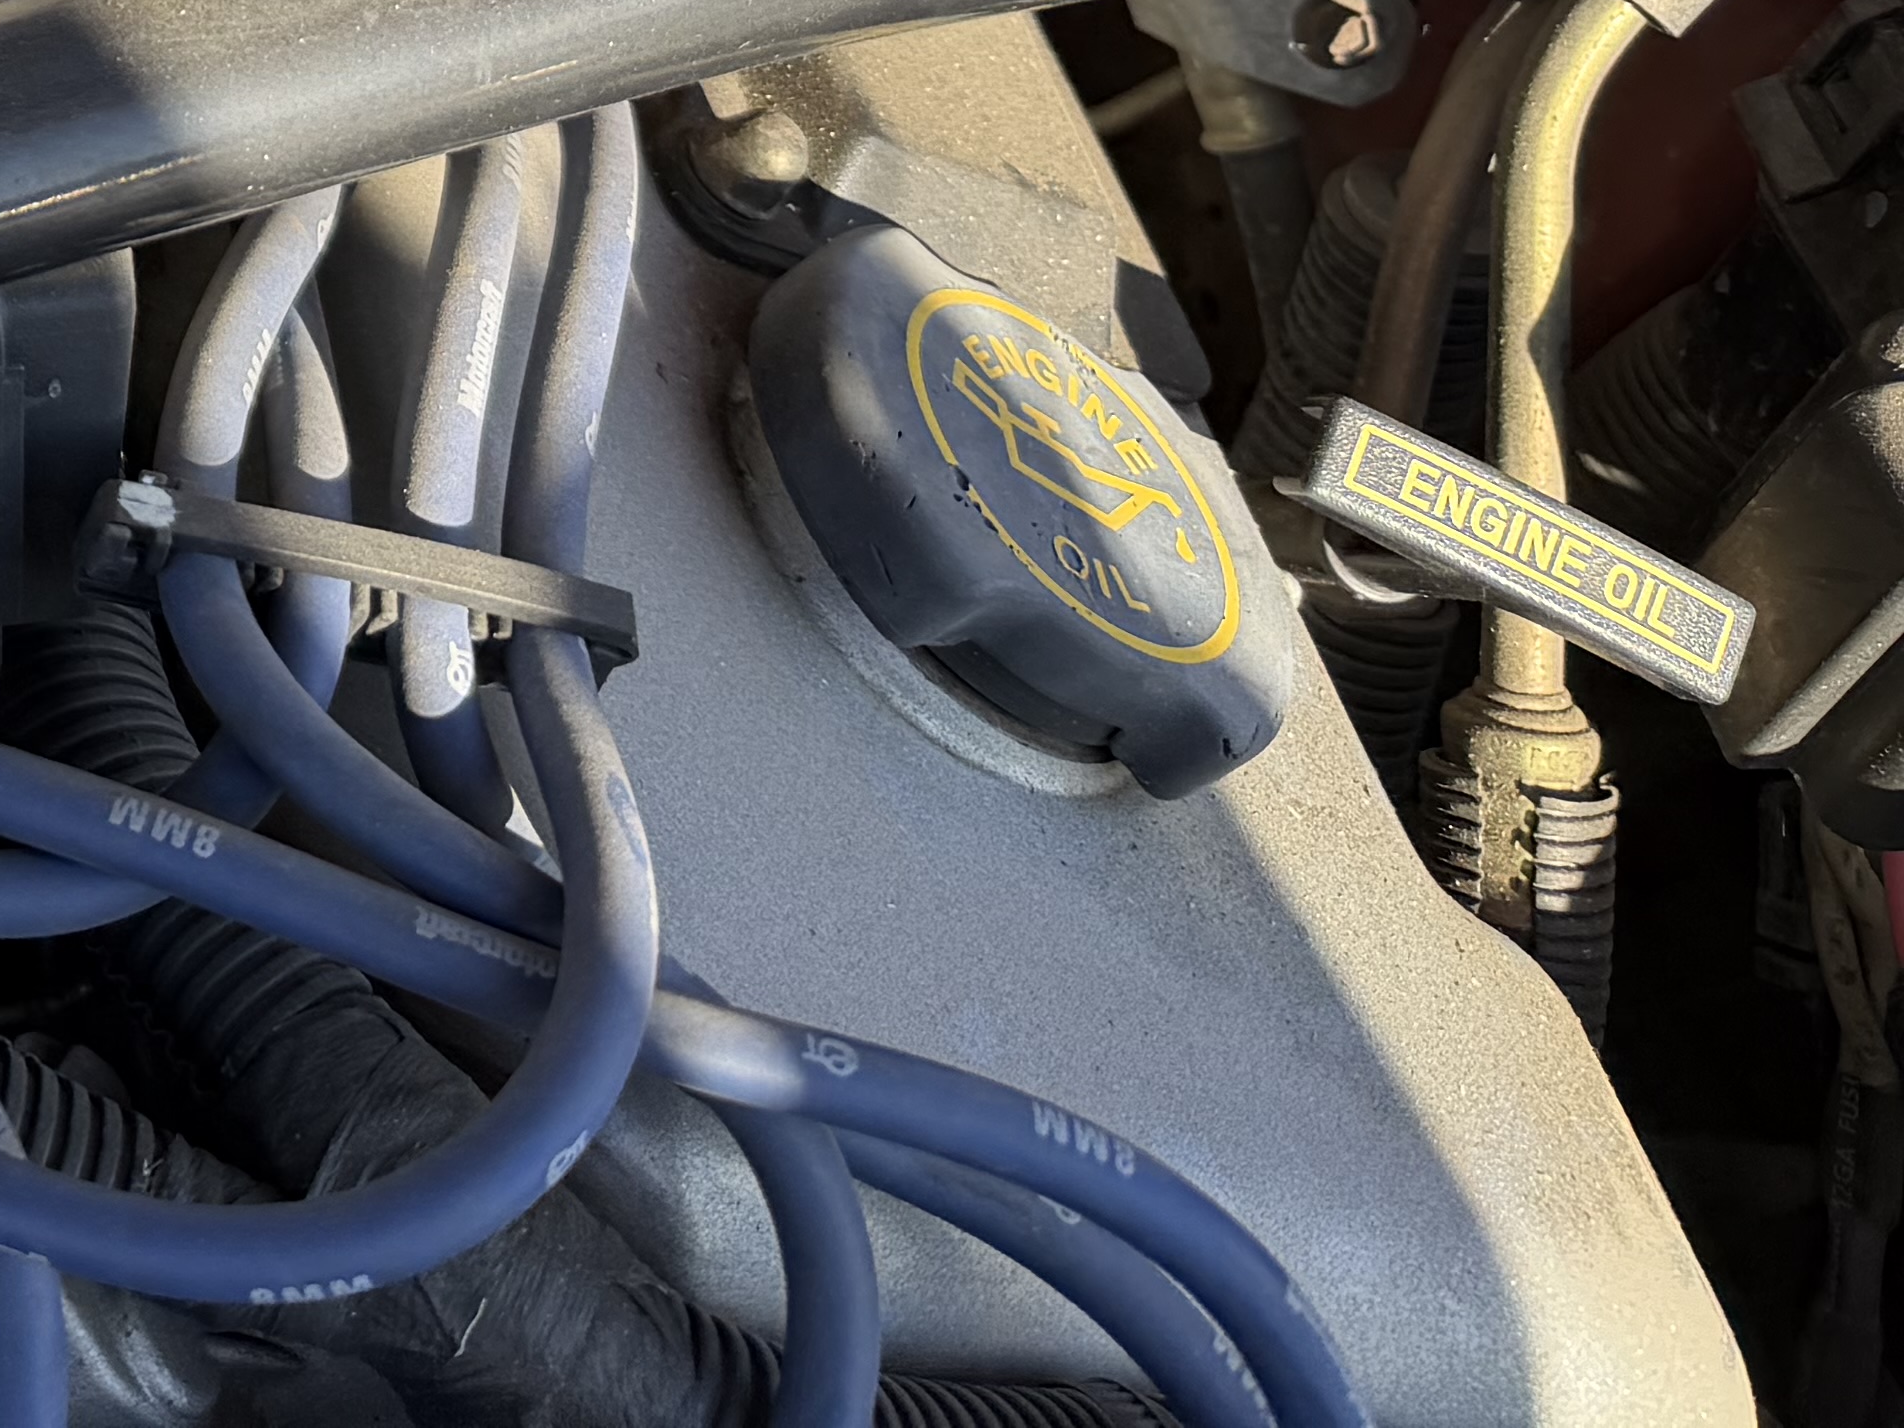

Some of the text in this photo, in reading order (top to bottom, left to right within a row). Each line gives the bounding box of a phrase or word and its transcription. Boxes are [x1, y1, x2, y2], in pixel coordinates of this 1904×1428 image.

[963, 334, 1158, 476] ENGINE
[1053, 535, 1151, 614] OIL
[1398, 458, 1676, 639] ENGINE OIL
[107, 796, 223, 861] 8MM
[414, 904, 559, 981] otorcraft
[1032, 1099, 1138, 1179] 8MM
